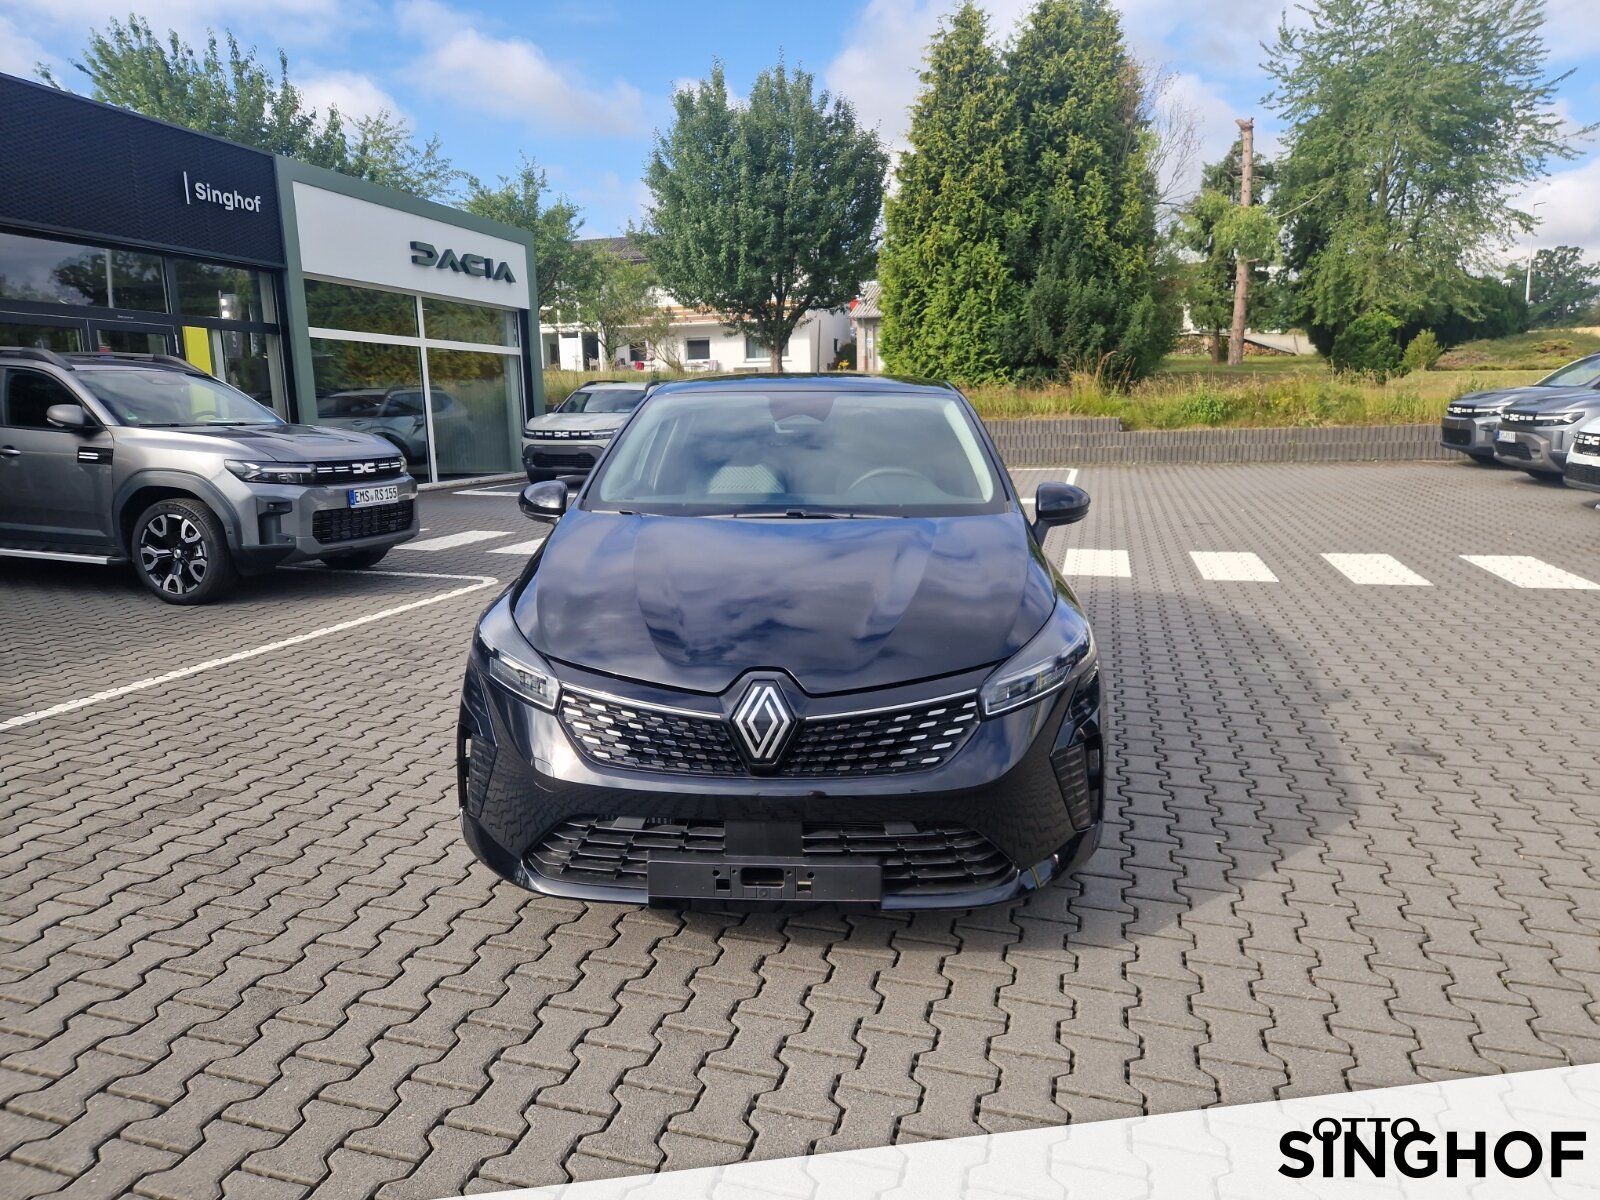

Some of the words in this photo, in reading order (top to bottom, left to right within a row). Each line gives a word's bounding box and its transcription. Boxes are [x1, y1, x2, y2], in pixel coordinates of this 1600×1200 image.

[194, 182, 261, 213] Singhof
[409, 241, 516, 283] DACIA
[354, 490, 370, 503] EMS
[374, 489, 384, 501] RS
[385, 487, 397, 500] 155
